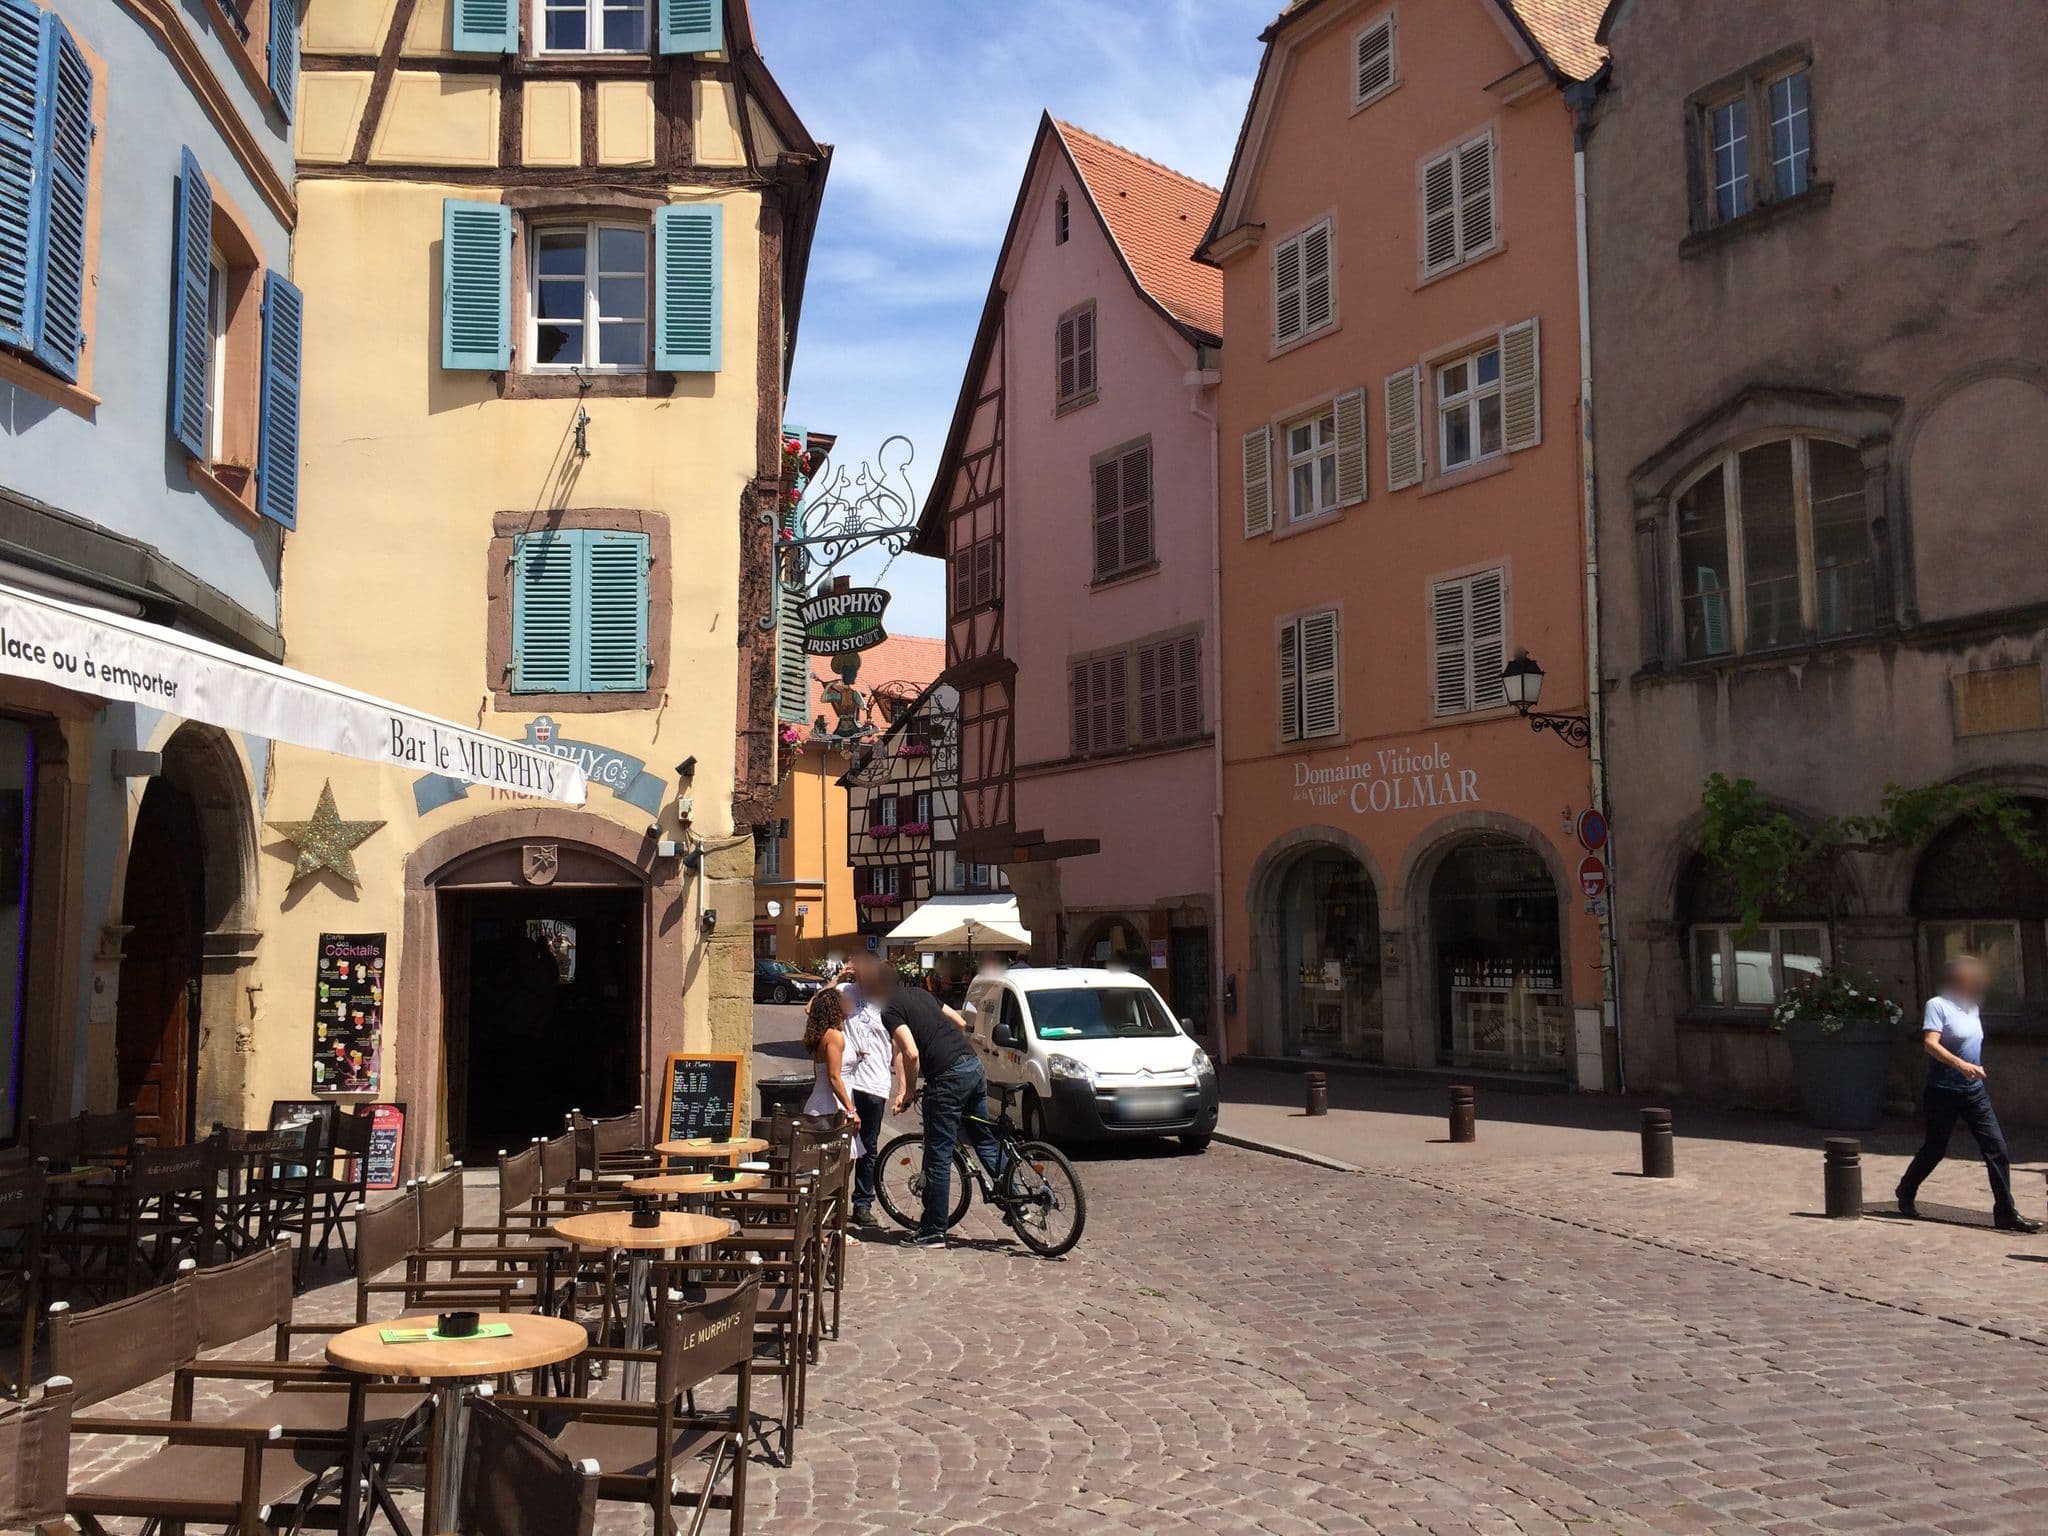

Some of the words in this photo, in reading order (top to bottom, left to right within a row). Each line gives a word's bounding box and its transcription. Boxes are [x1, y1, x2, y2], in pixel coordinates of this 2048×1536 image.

[801, 593, 882, 625] MURPHY'S
[807, 639, 841, 653] IRISH
[842, 630, 879, 650] STOUT
[53, 651, 77, 673] ou
[84, 652, 96, 679] à
[101, 664, 178, 698] emporter
[390, 717, 426, 763] Bar
[433, 729, 450, 769] le
[457, 737, 555, 793] MURPHY'S
[1295, 755, 1371, 787] Domaine
[1377, 742, 1450, 776] Viticole
[1308, 785, 1338, 806] Ville
[1350, 769, 1481, 814] COLMAR
[325, 944, 380, 957] Cocktails
[683, 1333, 696, 1351] LE
[697, 1311, 741, 1344] MURPHY'S
